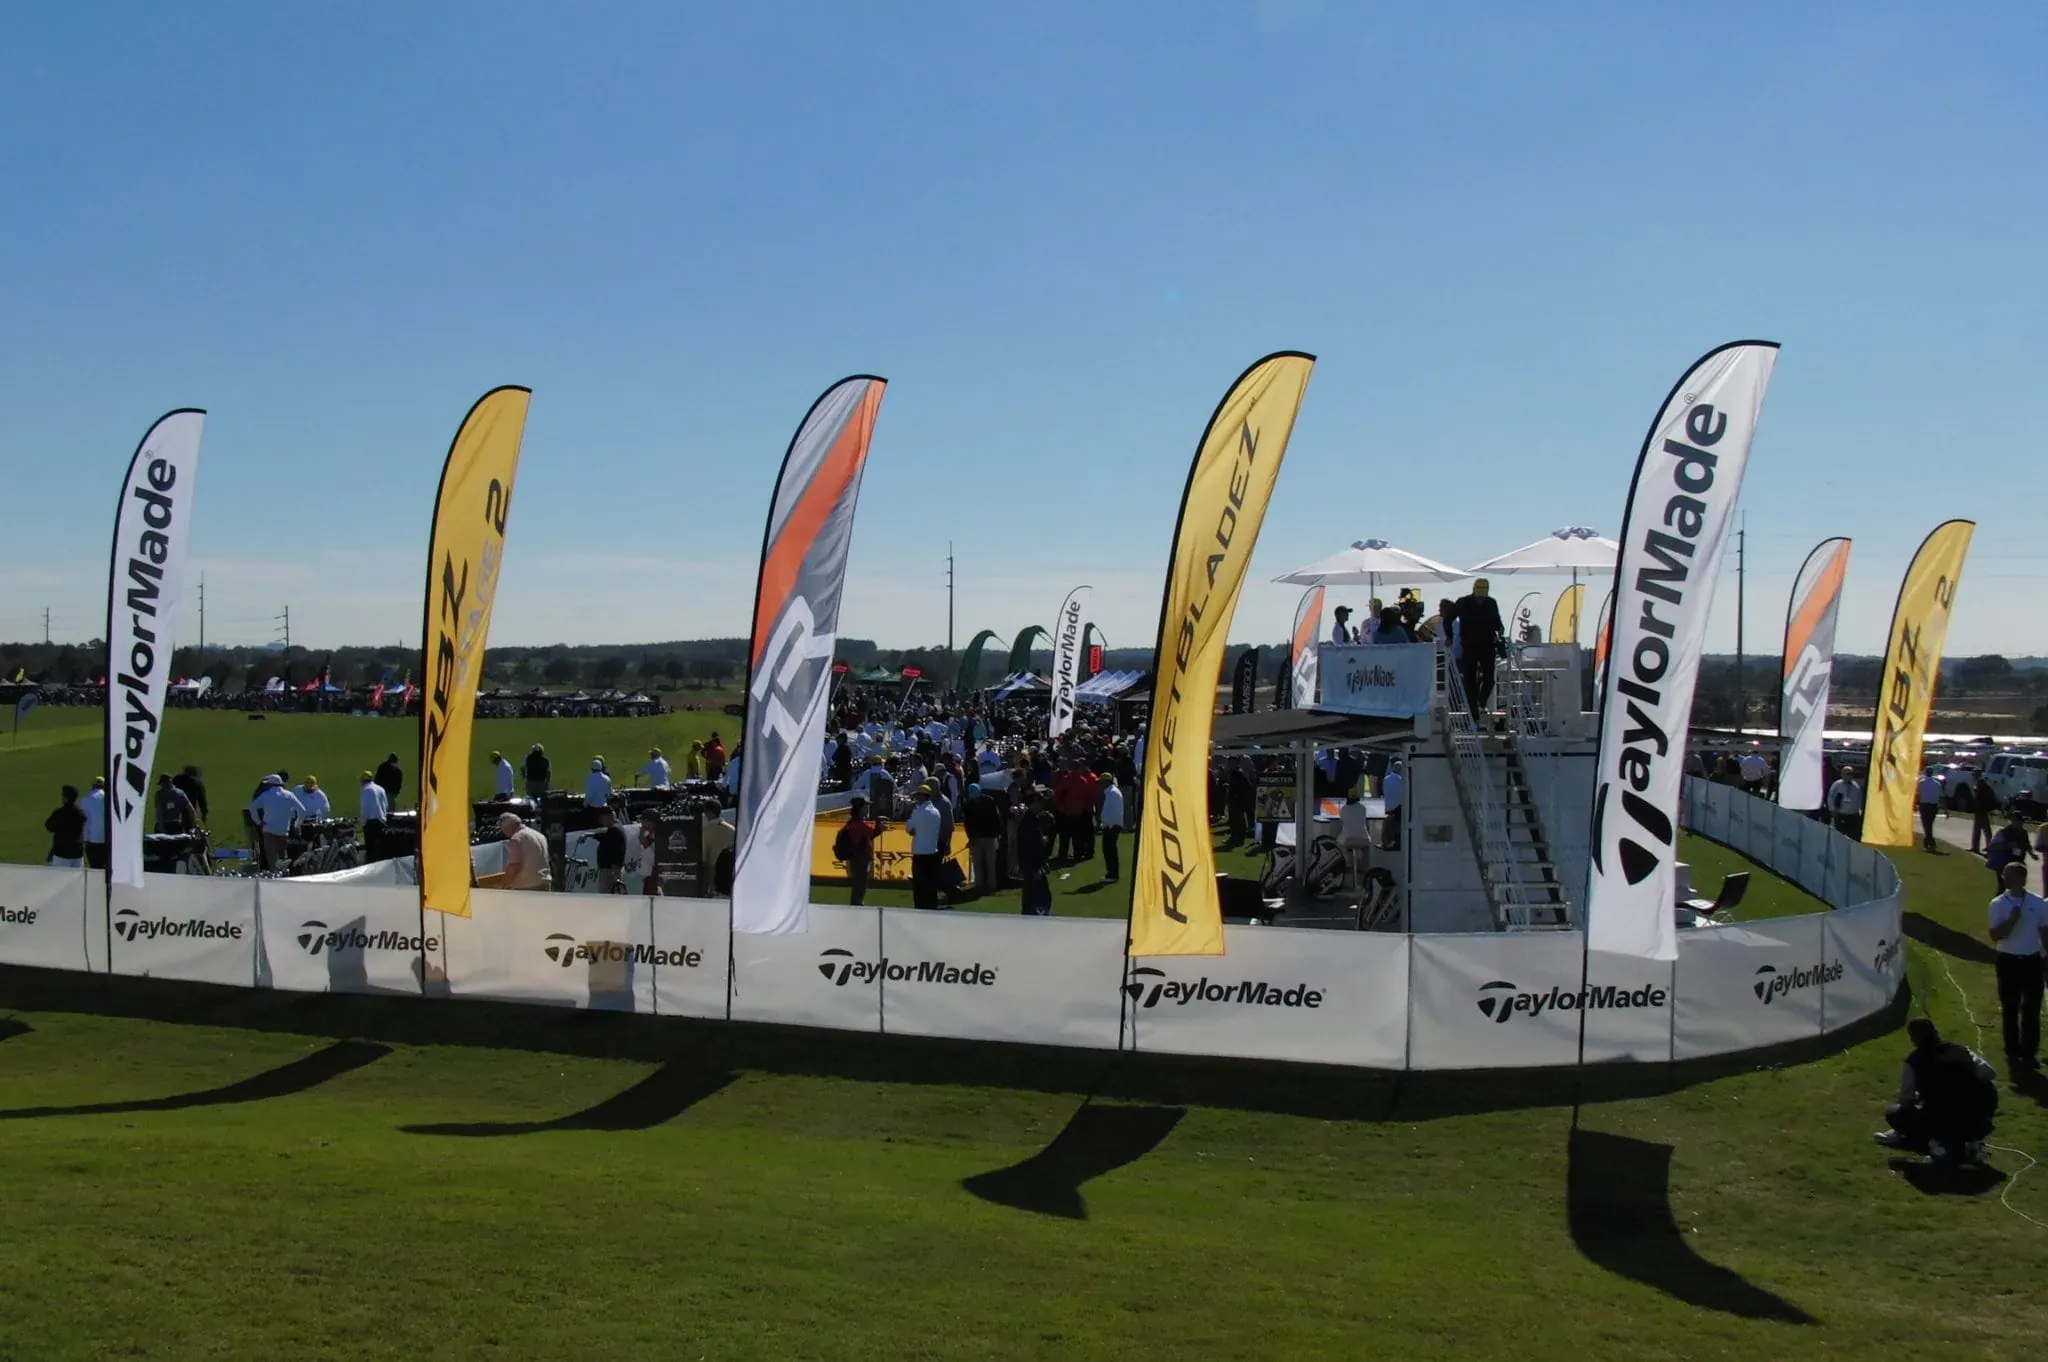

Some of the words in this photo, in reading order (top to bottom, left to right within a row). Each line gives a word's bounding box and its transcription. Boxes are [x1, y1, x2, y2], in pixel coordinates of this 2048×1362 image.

[114, 456, 177, 824] TaylorMade
[1052, 600, 1081, 720] TaylorMade
[1591, 403, 1727, 886] TaylorMade
[1161, 413, 1260, 925] ROCKETBLADEZ
[115, 909, 242, 942] TaylorMade
[297, 920, 439, 955] TaylorMade
[544, 933, 701, 967] TaylorMade
[818, 948, 997, 986] TaylorMade
[1119, 967, 1322, 1009] TaylorMade
[1478, 981, 1666, 1023] TaylorMade
[1754, 959, 1844, 1005] TaylorMade
